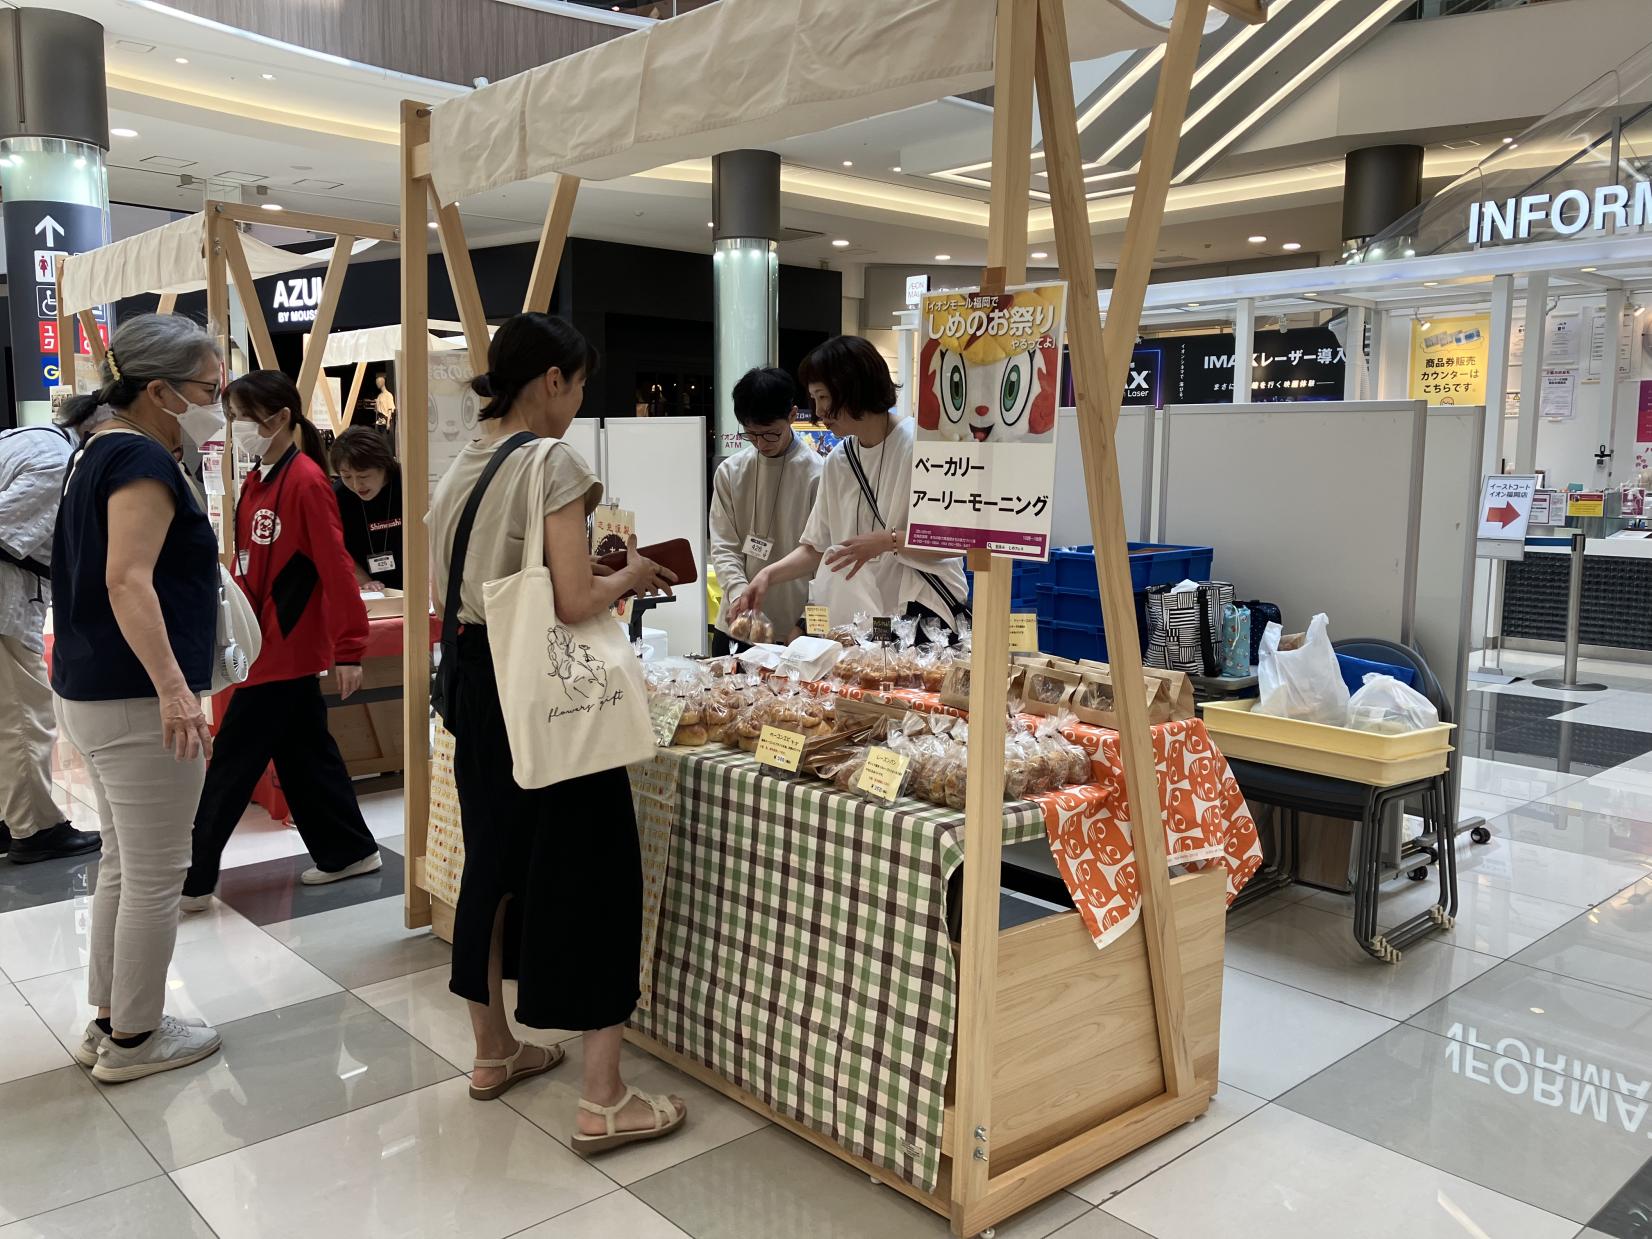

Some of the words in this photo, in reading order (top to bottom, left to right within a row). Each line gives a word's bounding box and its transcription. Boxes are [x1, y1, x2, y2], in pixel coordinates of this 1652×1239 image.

[278, 311, 289, 323] BY
[929, 305, 1055, 340] しめのお祭り
[1425, 356, 1476, 369] 商品券販売
[1421, 369, 1480, 381] カウンターは
[1127, 389, 1149, 397] Laser
[915, 456, 985, 477] ベーカリー
[912, 490, 1049, 517] アーリーモーニング
